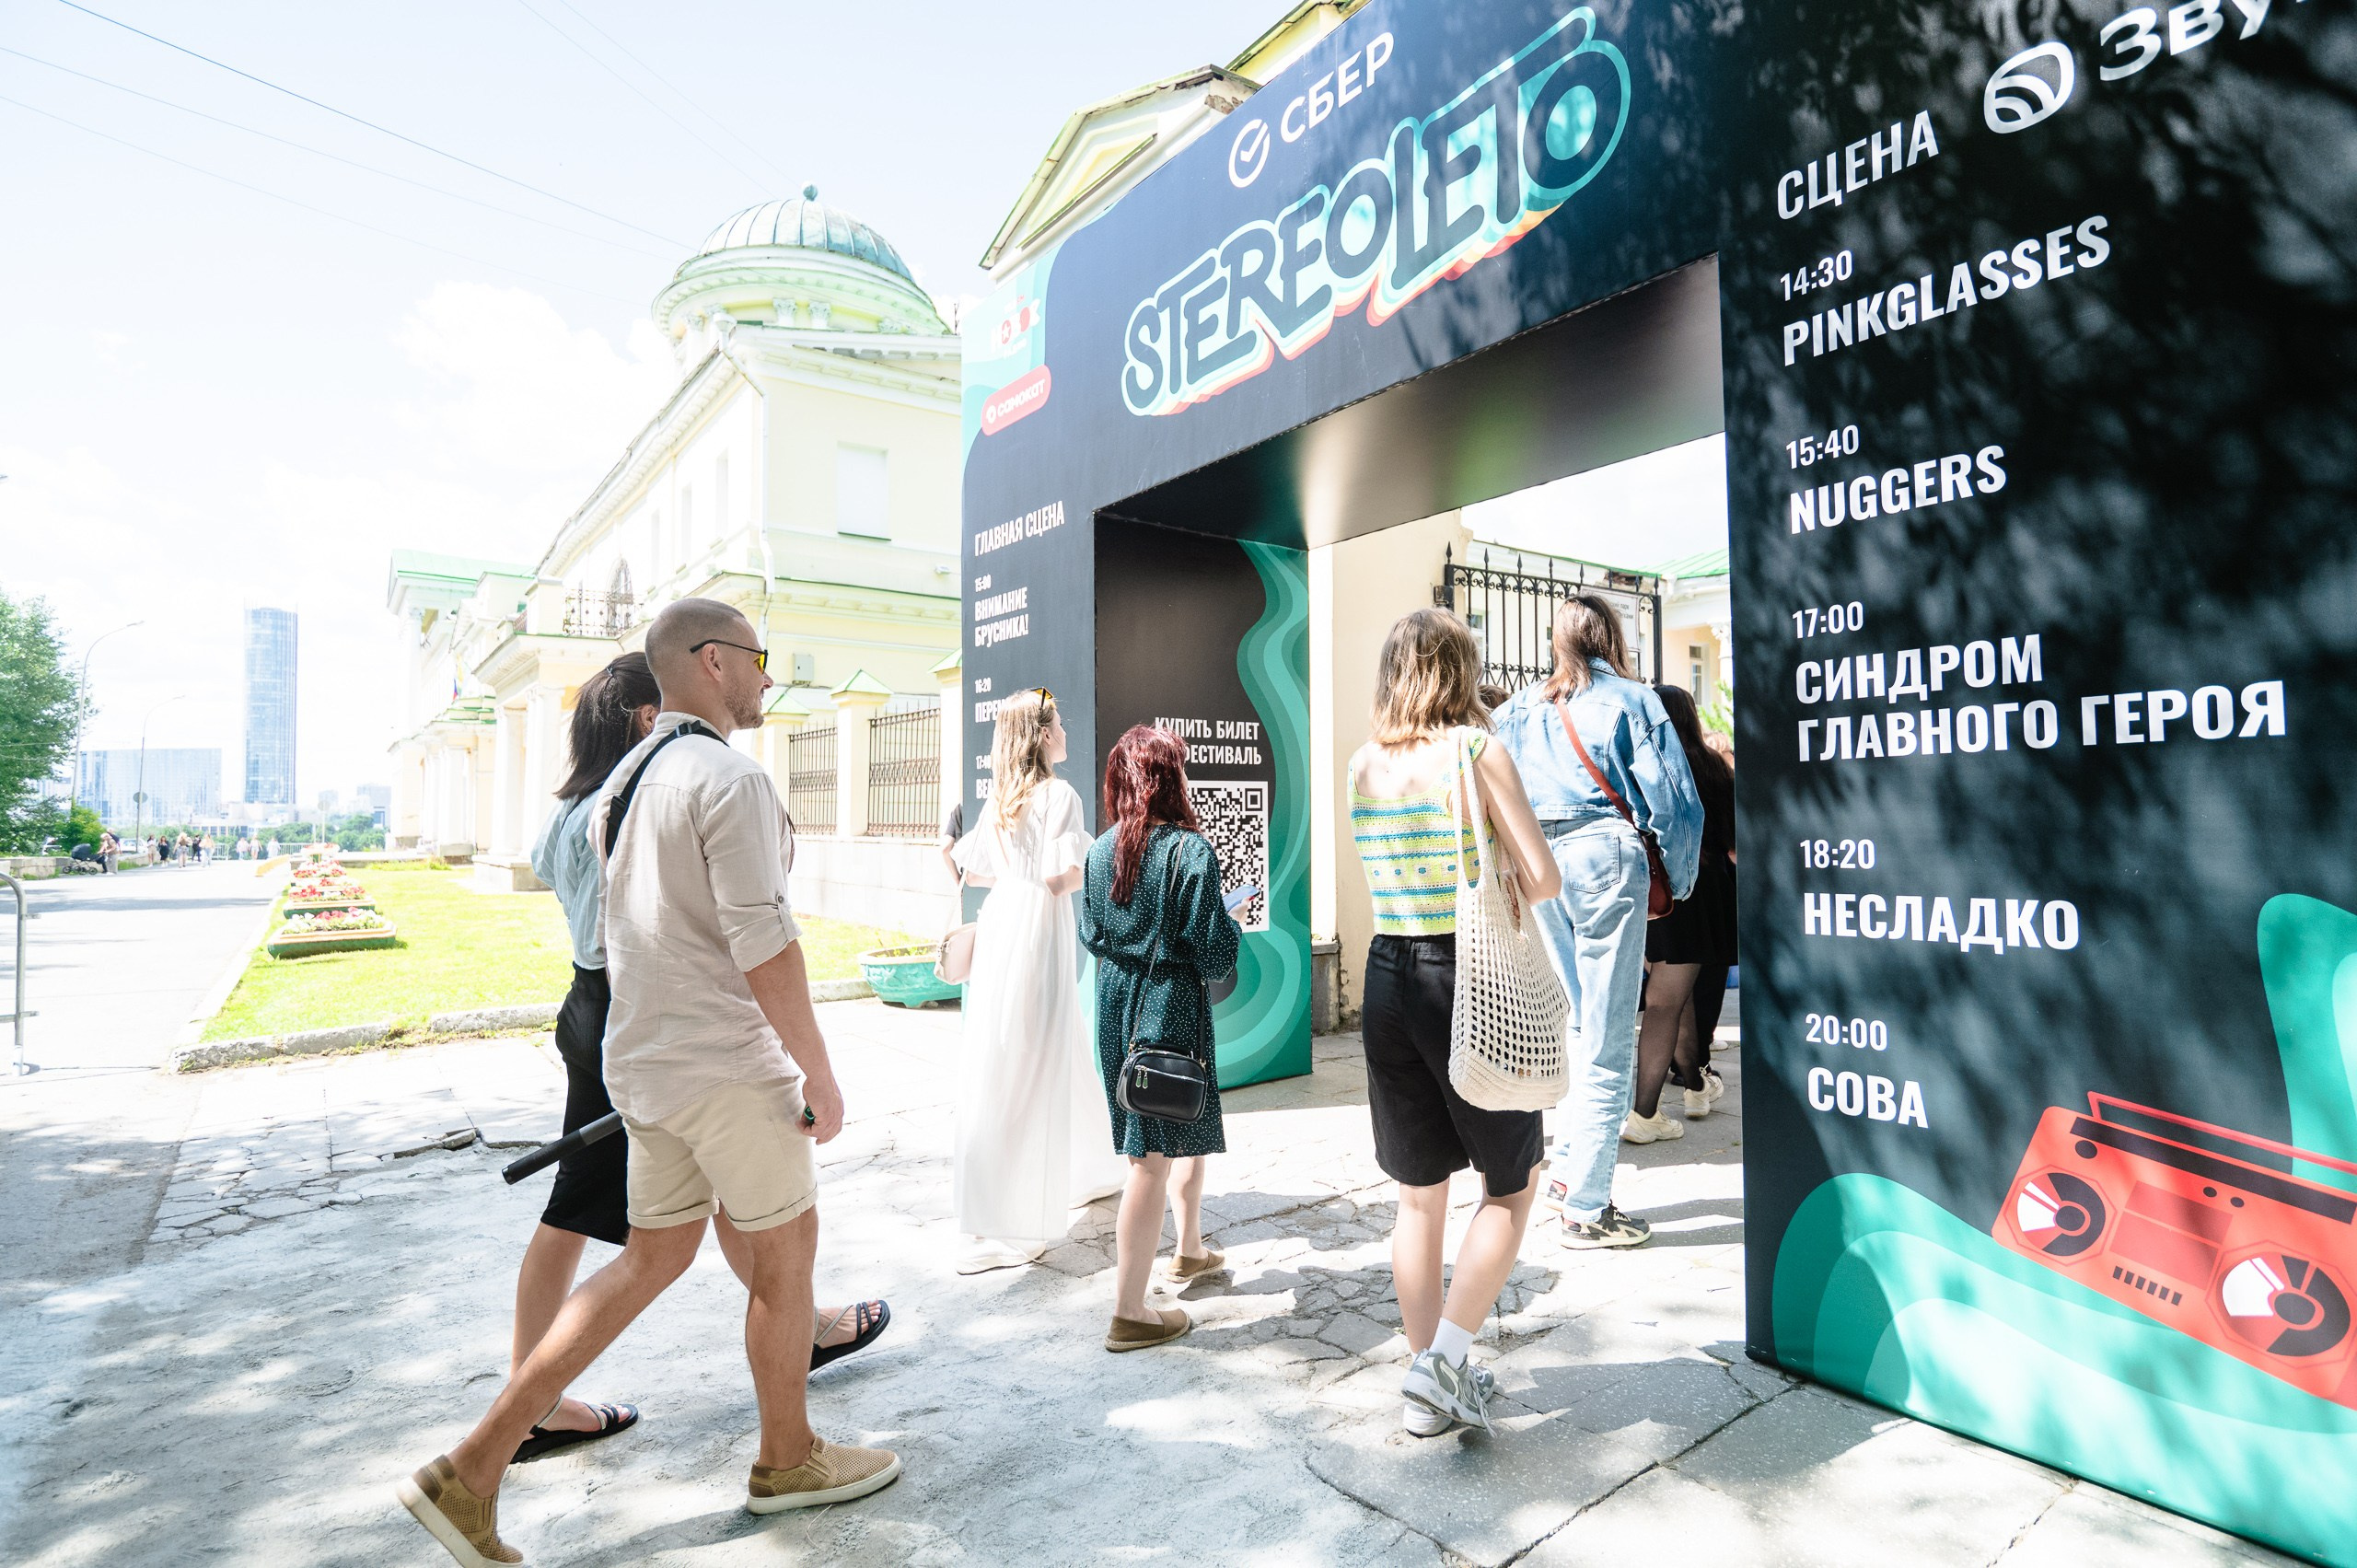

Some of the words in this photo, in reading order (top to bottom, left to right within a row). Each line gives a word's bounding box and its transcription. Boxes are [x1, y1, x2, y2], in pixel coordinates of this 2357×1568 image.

[1281, 32, 1394, 143] СБЕР
[1778, 110, 1939, 220] СЦЕНА
[2100, 0, 2305, 81] Зву
[1122, 6, 1631, 416] STEREOLETO
[1780, 250, 1852, 302] 14:30
[1783, 215, 2111, 366] PINKGLASSES
[1786, 424, 1860, 469] 15:40
[1790, 445, 2007, 534] NUGGERS
[974, 517, 1023, 556] ГЛАВНАЯ
[1025, 501, 1065, 538] СЦЕНА
[974, 587, 1028, 621] ВНИМАНИЕ
[974, 614, 1029, 647] БРУСНИКА!
[1793, 601, 1864, 639] 17:00
[1795, 633, 2043, 703] СИНДРОМ
[1155, 717, 1213, 738] КУПИТЬ
[1215, 720, 1260, 740] БИЛЕТ
[1798, 700, 2059, 761] ГЛАВНОГО
[2081, 680, 2286, 746] ГЕРОЯ
[1800, 839, 1875, 870] 18:20
[1804, 892, 2080, 955] НЕСЛАДКО
[1805, 1014, 1887, 1051] 20:00
[1807, 1067, 1929, 1129] СОВА
